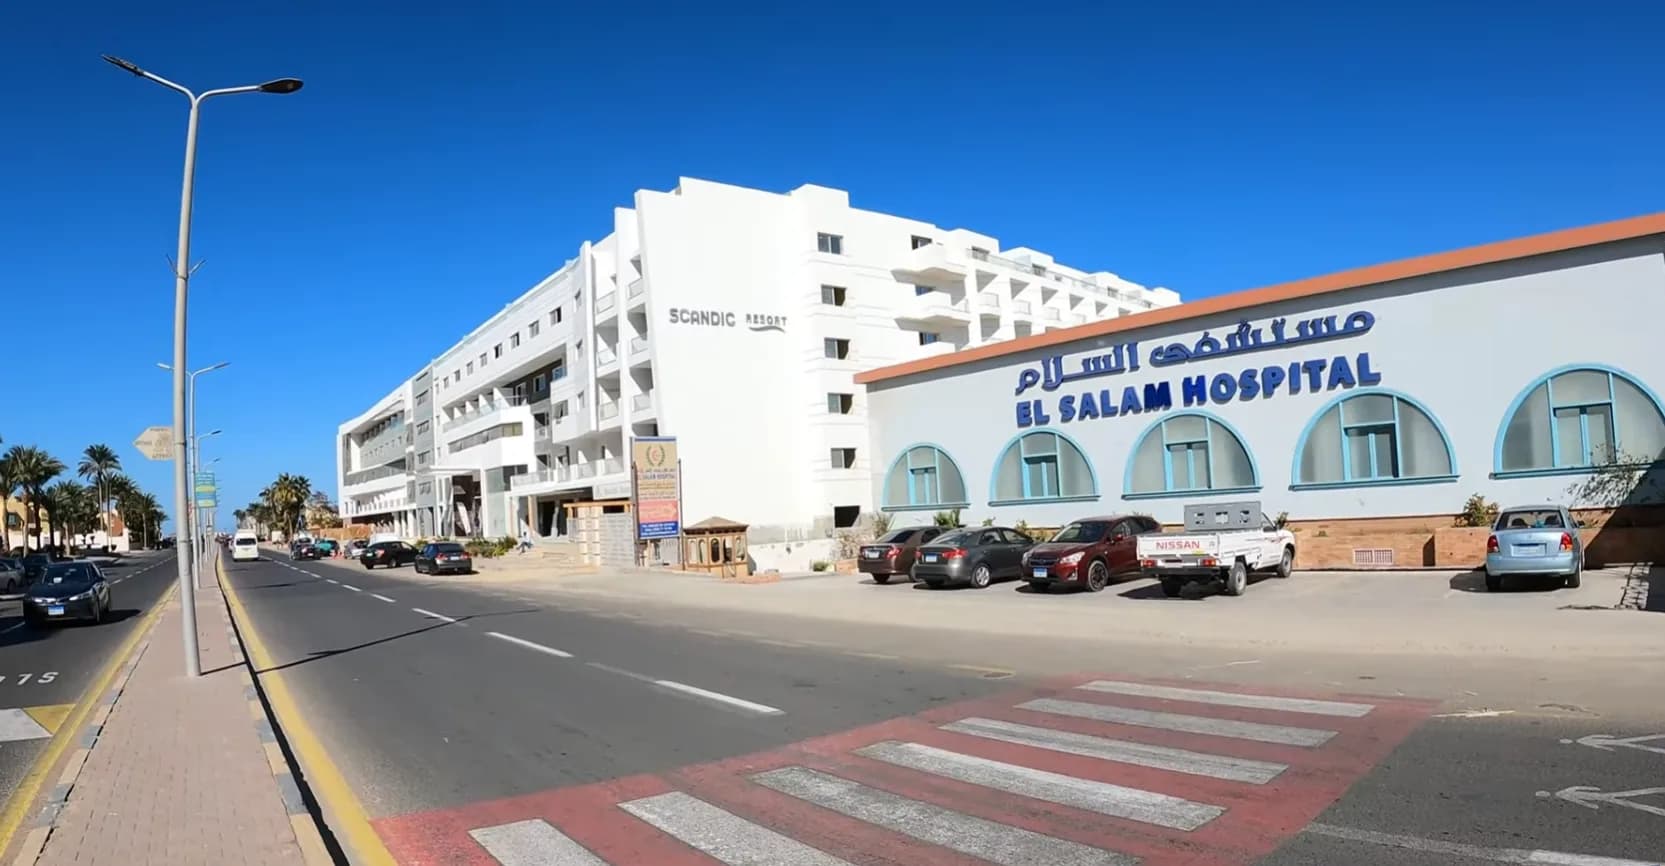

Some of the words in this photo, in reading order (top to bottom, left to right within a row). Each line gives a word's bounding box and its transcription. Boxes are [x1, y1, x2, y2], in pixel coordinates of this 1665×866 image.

[669, 307, 736, 327] SCANDIC
[745, 313, 788, 326] RESORT
[1149, 311, 1376, 368] مستشفى
[1015, 343, 1140, 395] السلام
[1016, 401, 1051, 428] EL
[1058, 382, 1173, 424] SALAM
[1181, 353, 1383, 406] HOSPITAL
[1156, 540, 1201, 550] NISSAN
